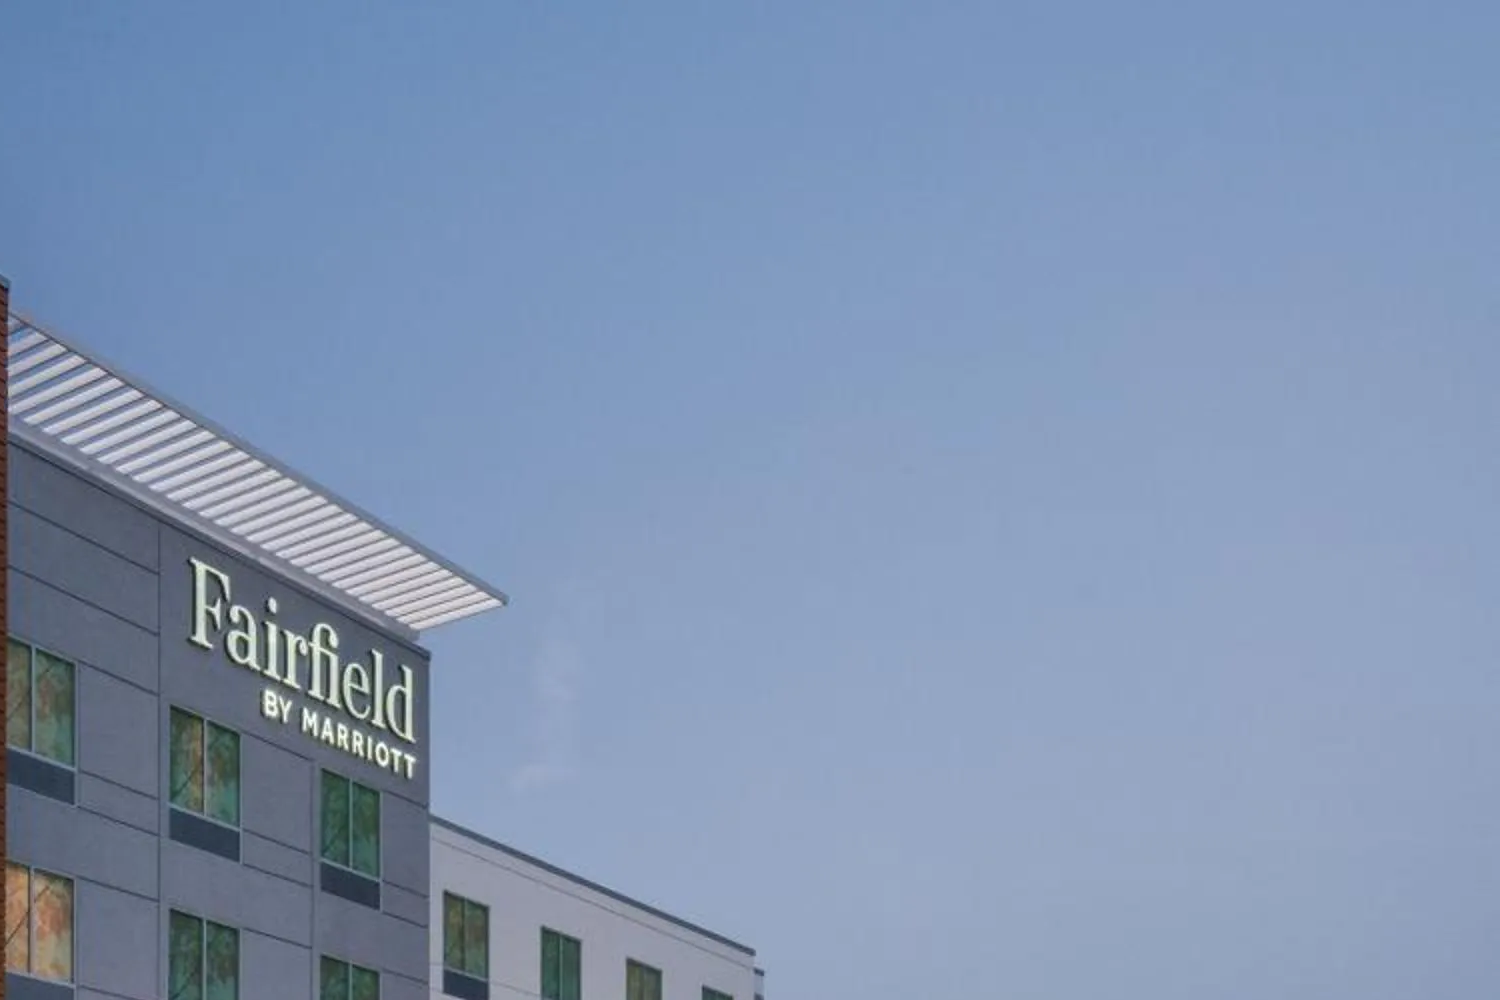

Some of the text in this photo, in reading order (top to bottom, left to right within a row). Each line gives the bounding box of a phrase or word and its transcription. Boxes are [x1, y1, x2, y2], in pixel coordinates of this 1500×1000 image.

[187, 557, 416, 743] Fairfield
[262, 689, 417, 778] BY MARRIOTT
